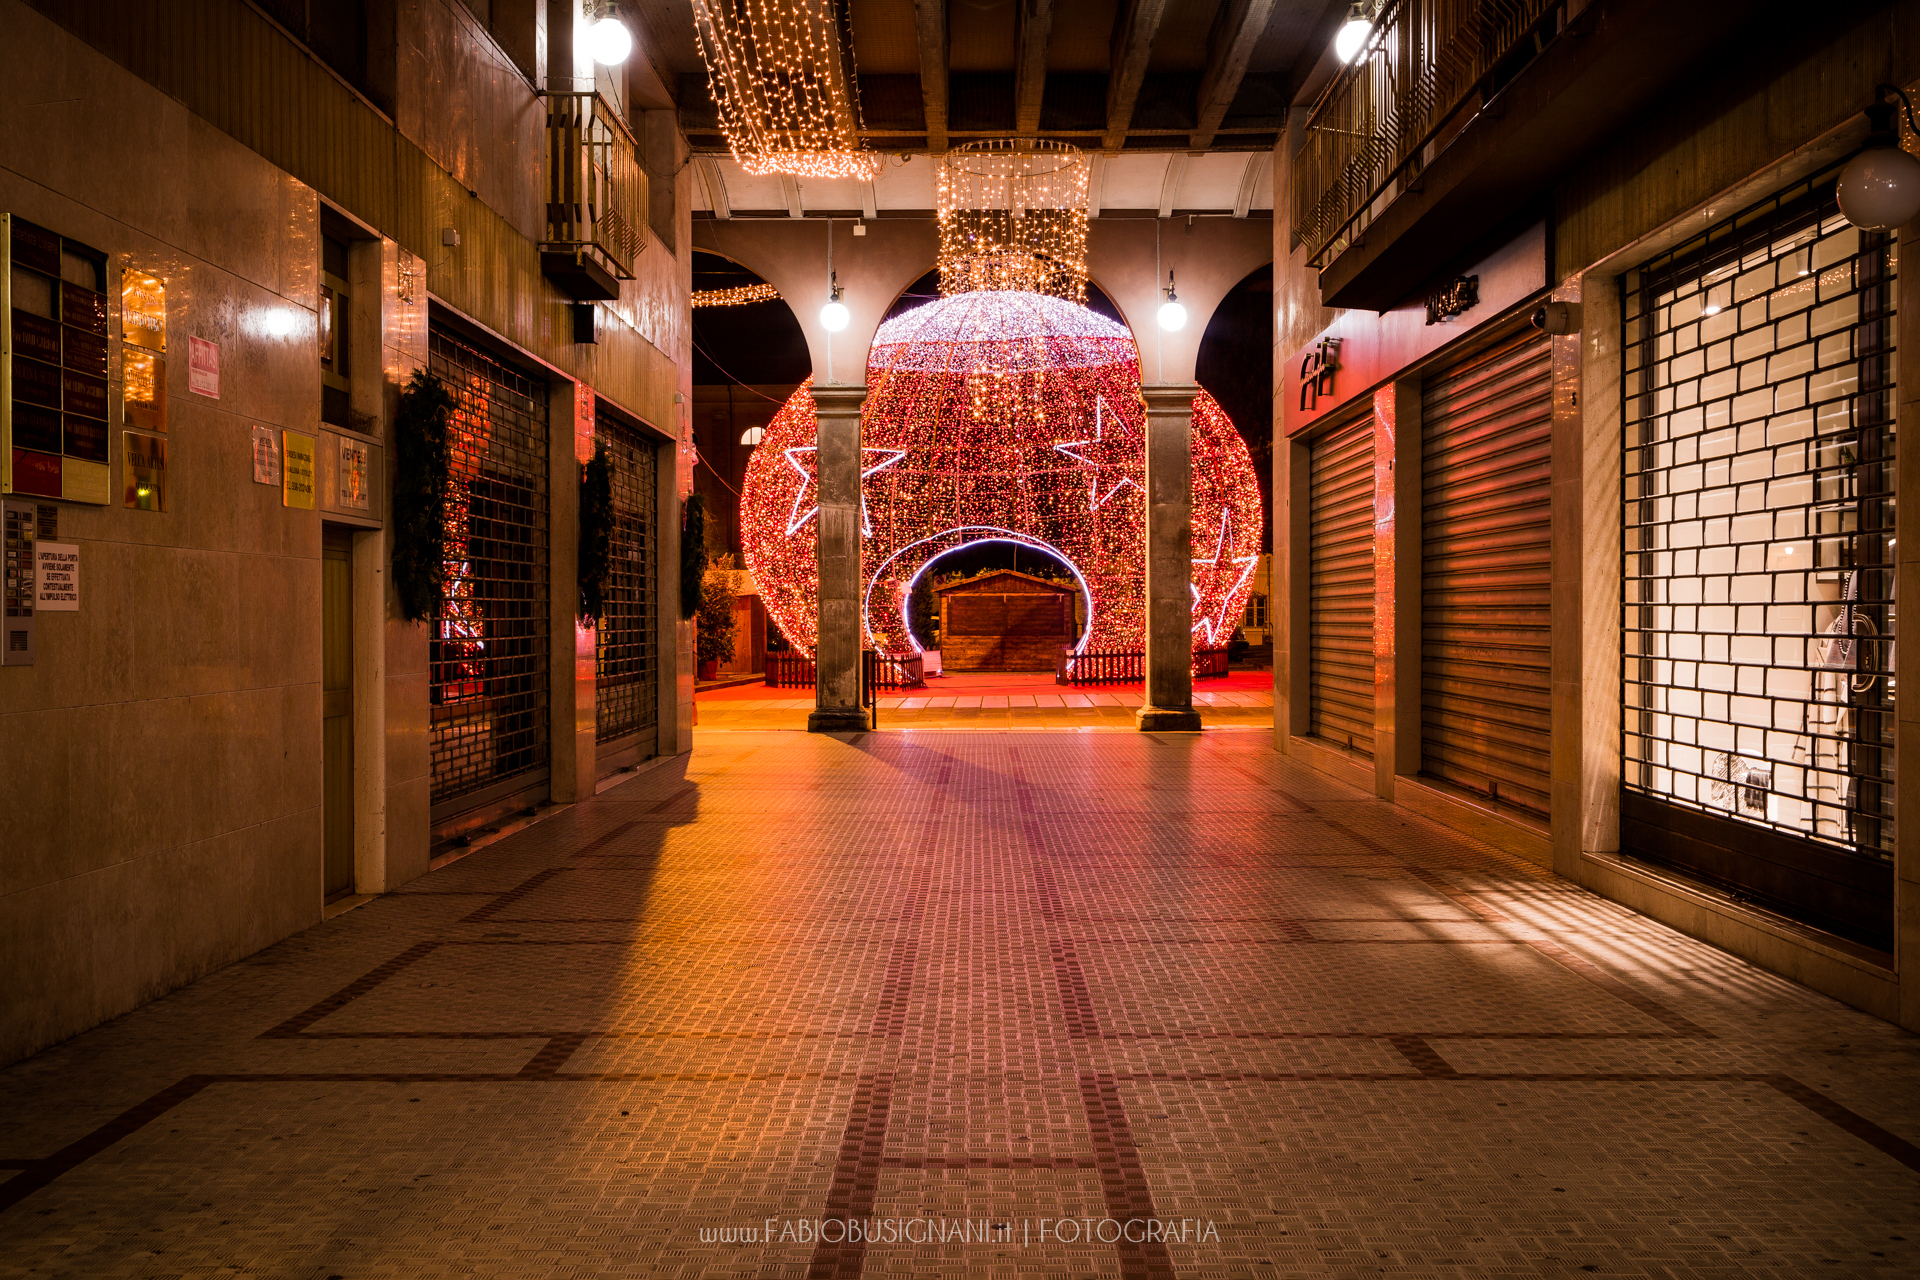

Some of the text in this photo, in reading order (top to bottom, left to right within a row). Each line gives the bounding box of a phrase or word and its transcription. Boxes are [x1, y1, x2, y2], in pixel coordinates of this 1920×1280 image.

[190, 342, 218, 370] AFFITTASI
[14, 363, 37, 382] NERINA
[38, 552, 78, 562] L'APERTURA DELLA PORTA
[42, 562, 75, 572] AVVIENE SOLAMENTE
[51, 573, 70, 581] EFFETTUATA
[43, 582, 74, 591] CONTESTUALMENTE
[60, 593, 77, 601] ELETTRICO
